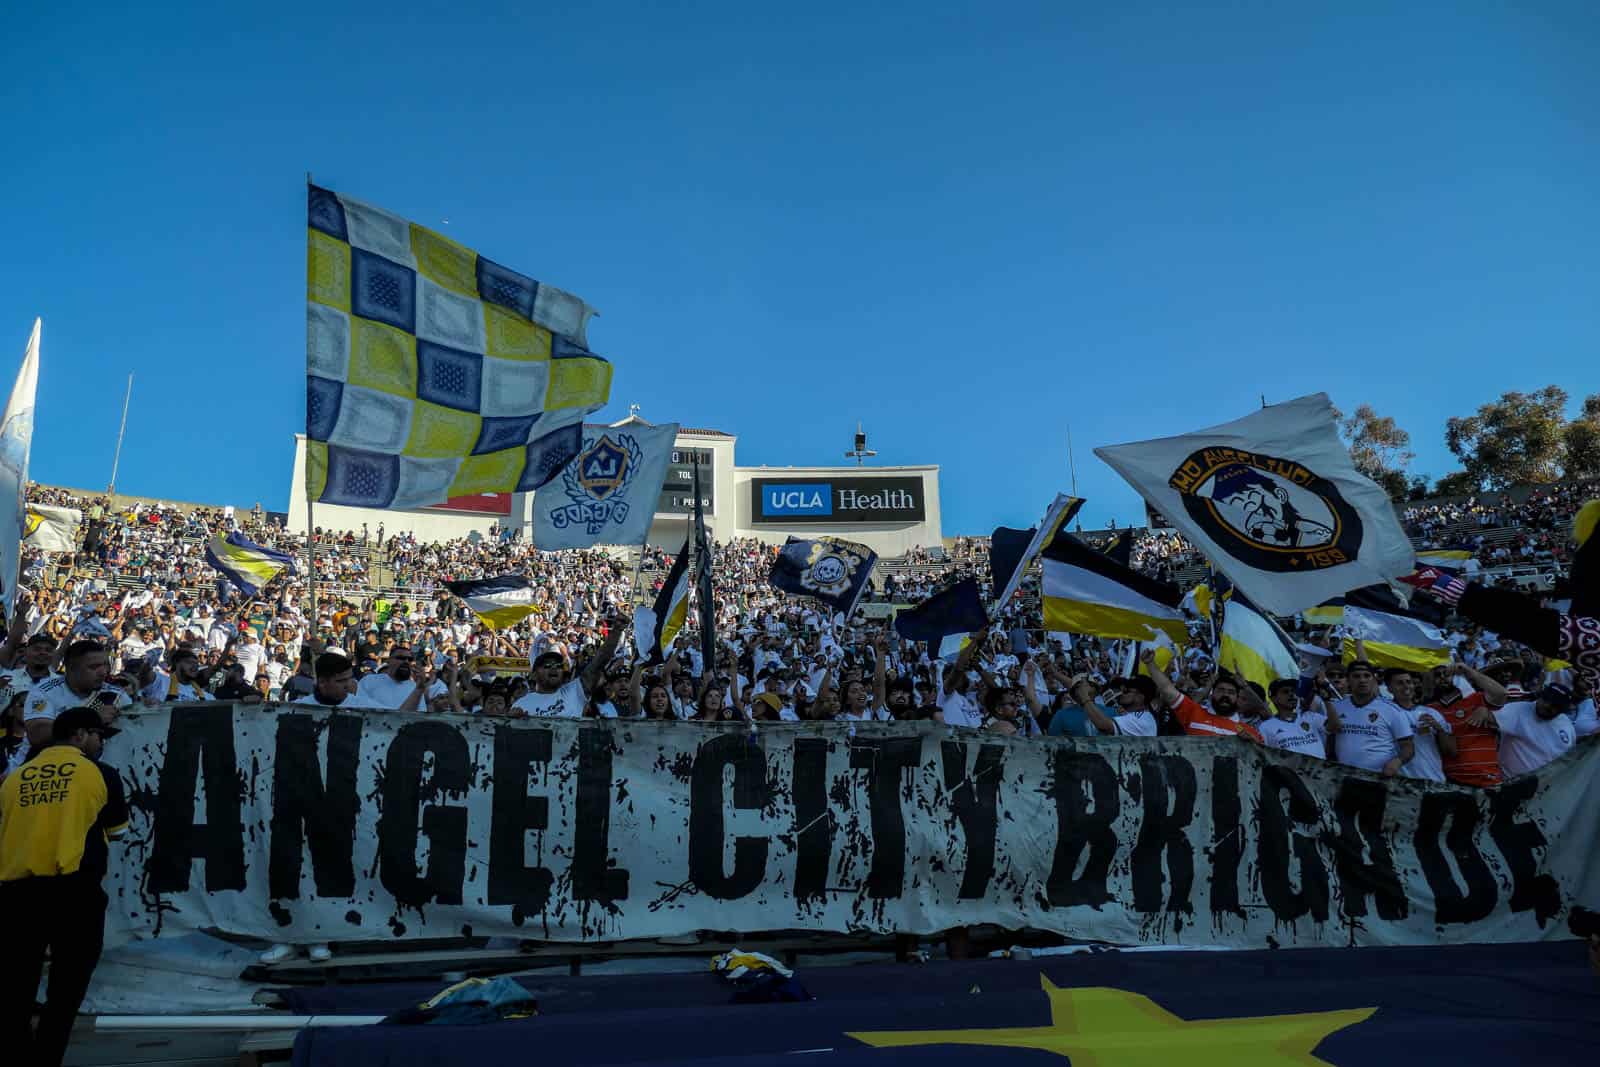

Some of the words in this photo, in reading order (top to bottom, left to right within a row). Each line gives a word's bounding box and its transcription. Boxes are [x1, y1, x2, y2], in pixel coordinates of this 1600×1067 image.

[679, 471, 691, 479] TOL
[683, 497, 710, 506] PED
[771, 491, 823, 509] UCLA
[838, 489, 915, 511] Health
[21, 762, 77, 781] CSC
[20, 778, 72, 795] EVENT
[20, 790, 69, 808] STAFF
[148, 706, 630, 906] ANGEL
[689, 733, 1004, 900] CITY
[1047, 751, 1560, 924] BRIGADE
